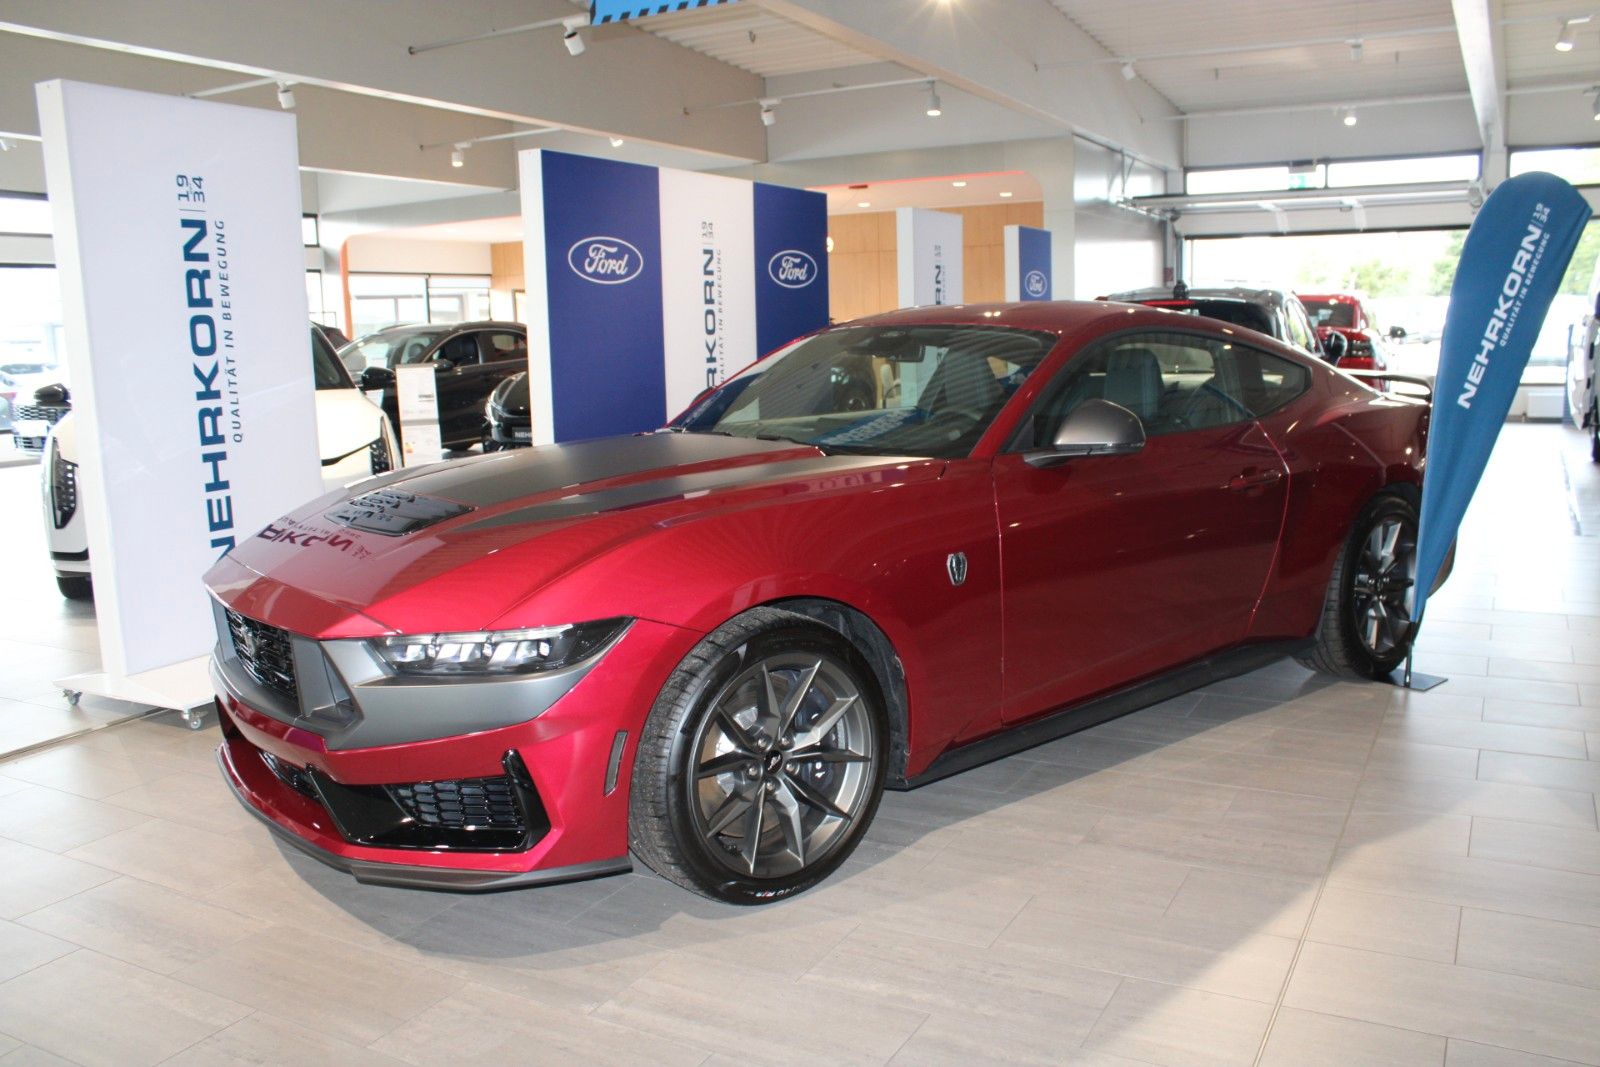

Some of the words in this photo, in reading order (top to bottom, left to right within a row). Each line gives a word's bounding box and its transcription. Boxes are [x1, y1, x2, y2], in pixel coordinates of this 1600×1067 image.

[176, 174, 190, 201] 19
[192, 176, 205, 203] 34
[1532, 202, 1544, 220] 19
[1539, 206, 1550, 224] 34
[215, 220, 232, 320] BEWEGUNG
[584, 243, 629, 275] Ford
[779, 255, 808, 280] Ford
[1519, 287, 1529, 299] IN
[703, 249, 717, 388] RKORN
[1457, 223, 1543, 410] NEHRKORN
[224, 330, 235, 348] IN
[225, 356, 243, 443] QUALITÄT
